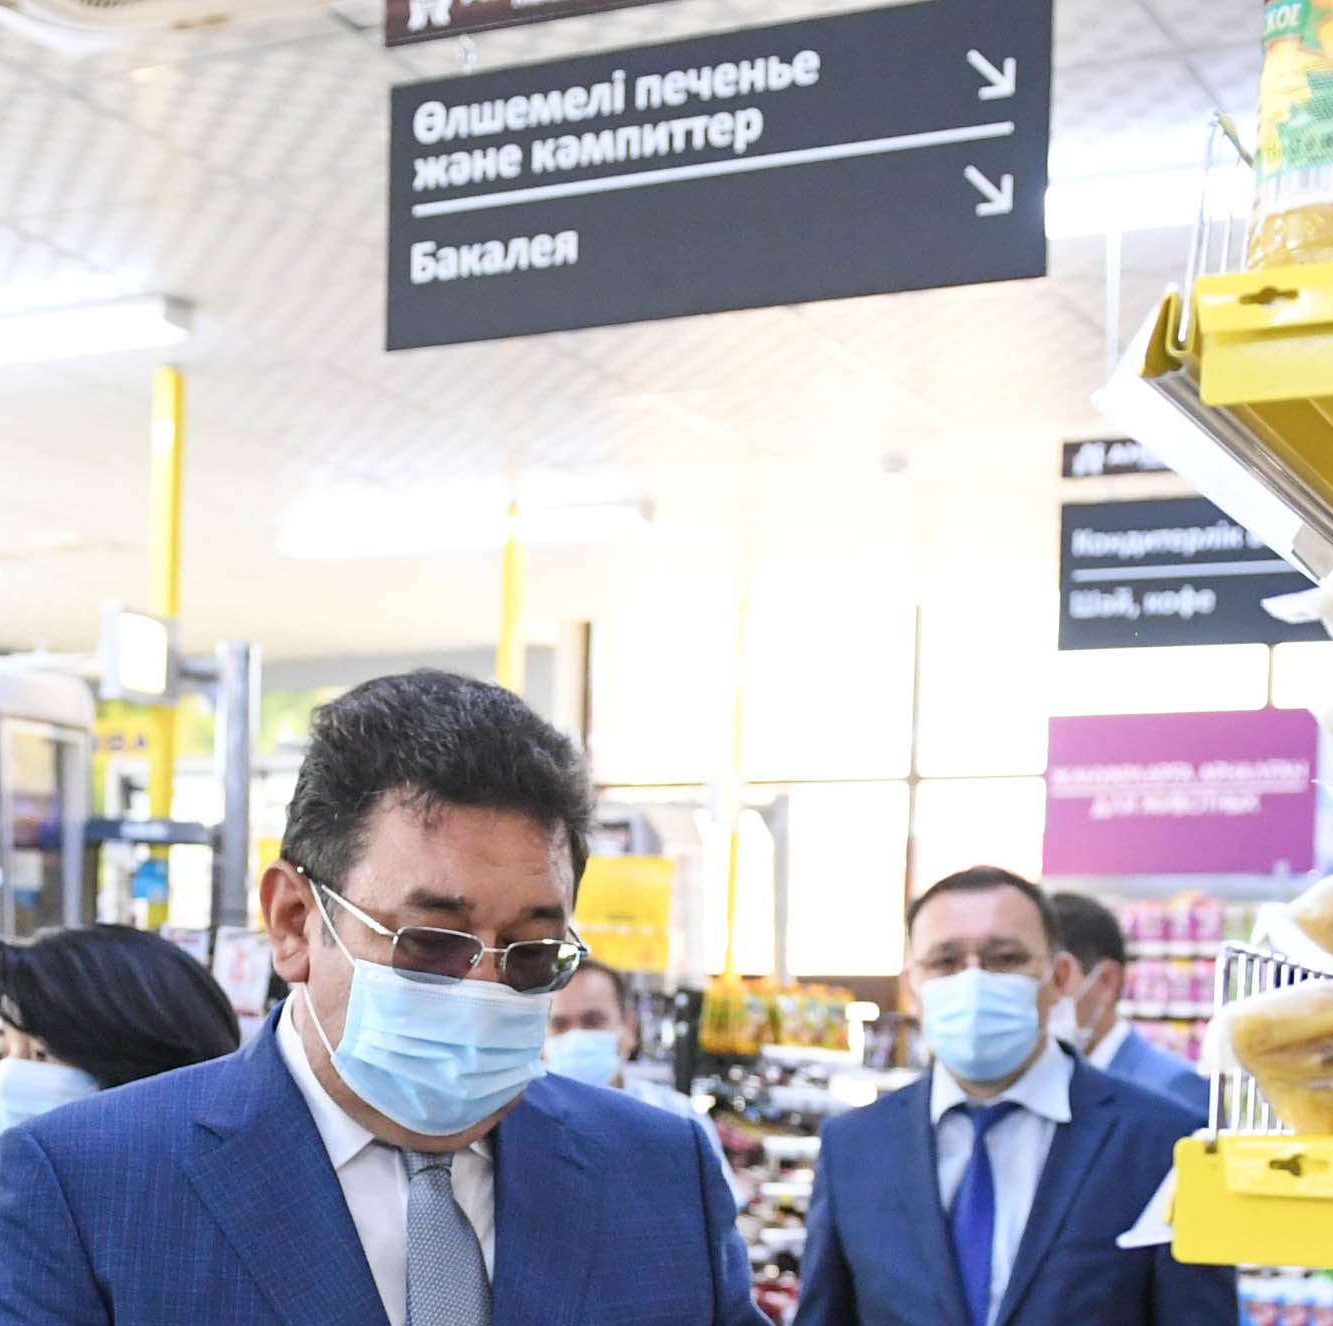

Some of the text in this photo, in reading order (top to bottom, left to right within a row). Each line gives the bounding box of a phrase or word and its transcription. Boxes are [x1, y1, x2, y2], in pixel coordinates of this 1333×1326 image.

[413, 48, 821, 144] Өлшемелі печенье
[413, 106, 764, 191] және кәмпиттер
[410, 229, 580, 284] Бакалея
[1143, 584, 1216, 619] кофе
